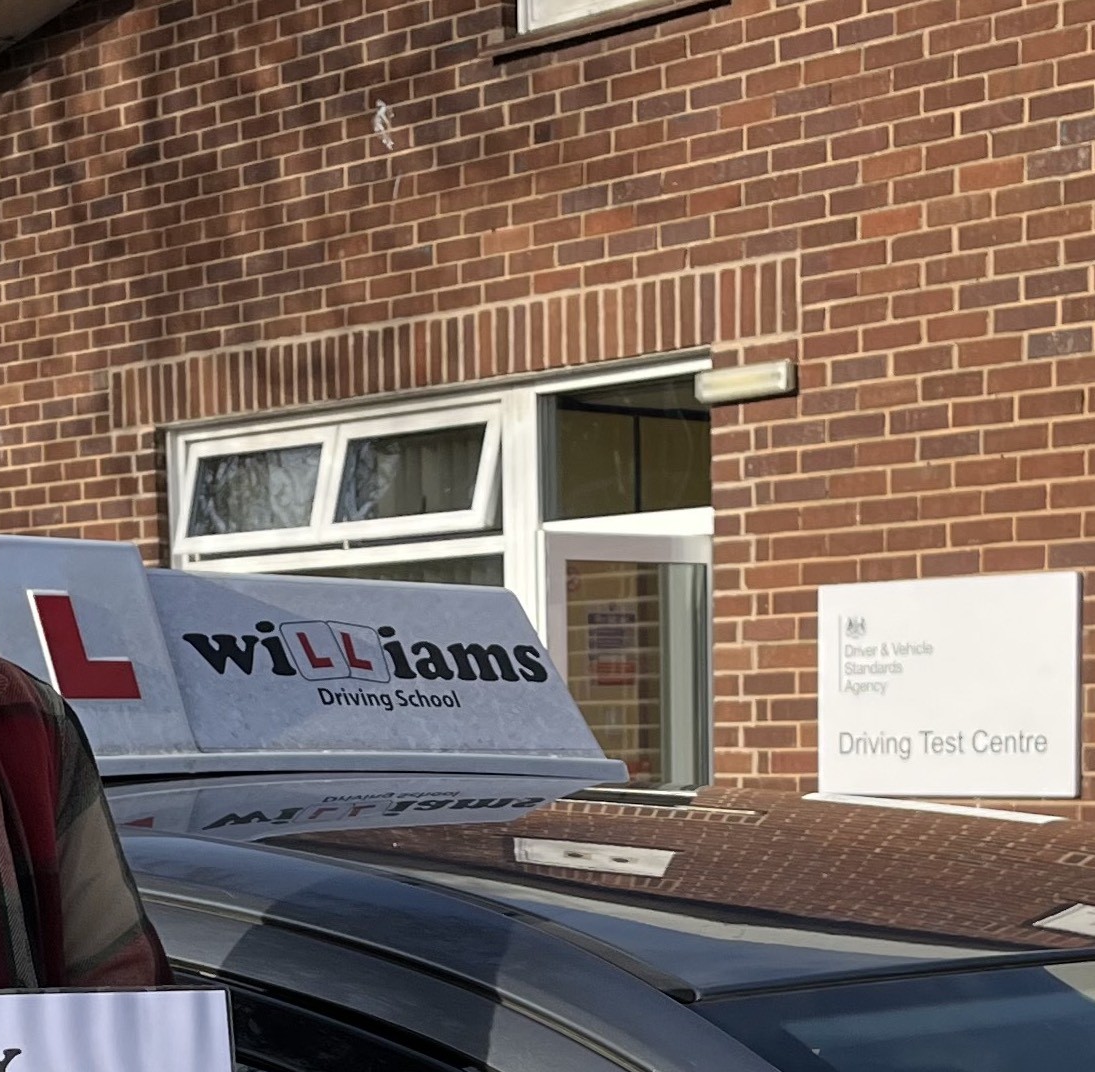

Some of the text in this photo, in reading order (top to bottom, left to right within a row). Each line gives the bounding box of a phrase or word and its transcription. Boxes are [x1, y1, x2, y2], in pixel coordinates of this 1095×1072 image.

[33, 593, 142, 700] L
[844, 641, 934, 658] Driver & Vehicle
[844, 661, 903, 675] Standards
[844, 680, 887, 695] Agency
[317, 687, 462, 711] Driving School
[839, 729, 1048, 759] Driving Test Centre
